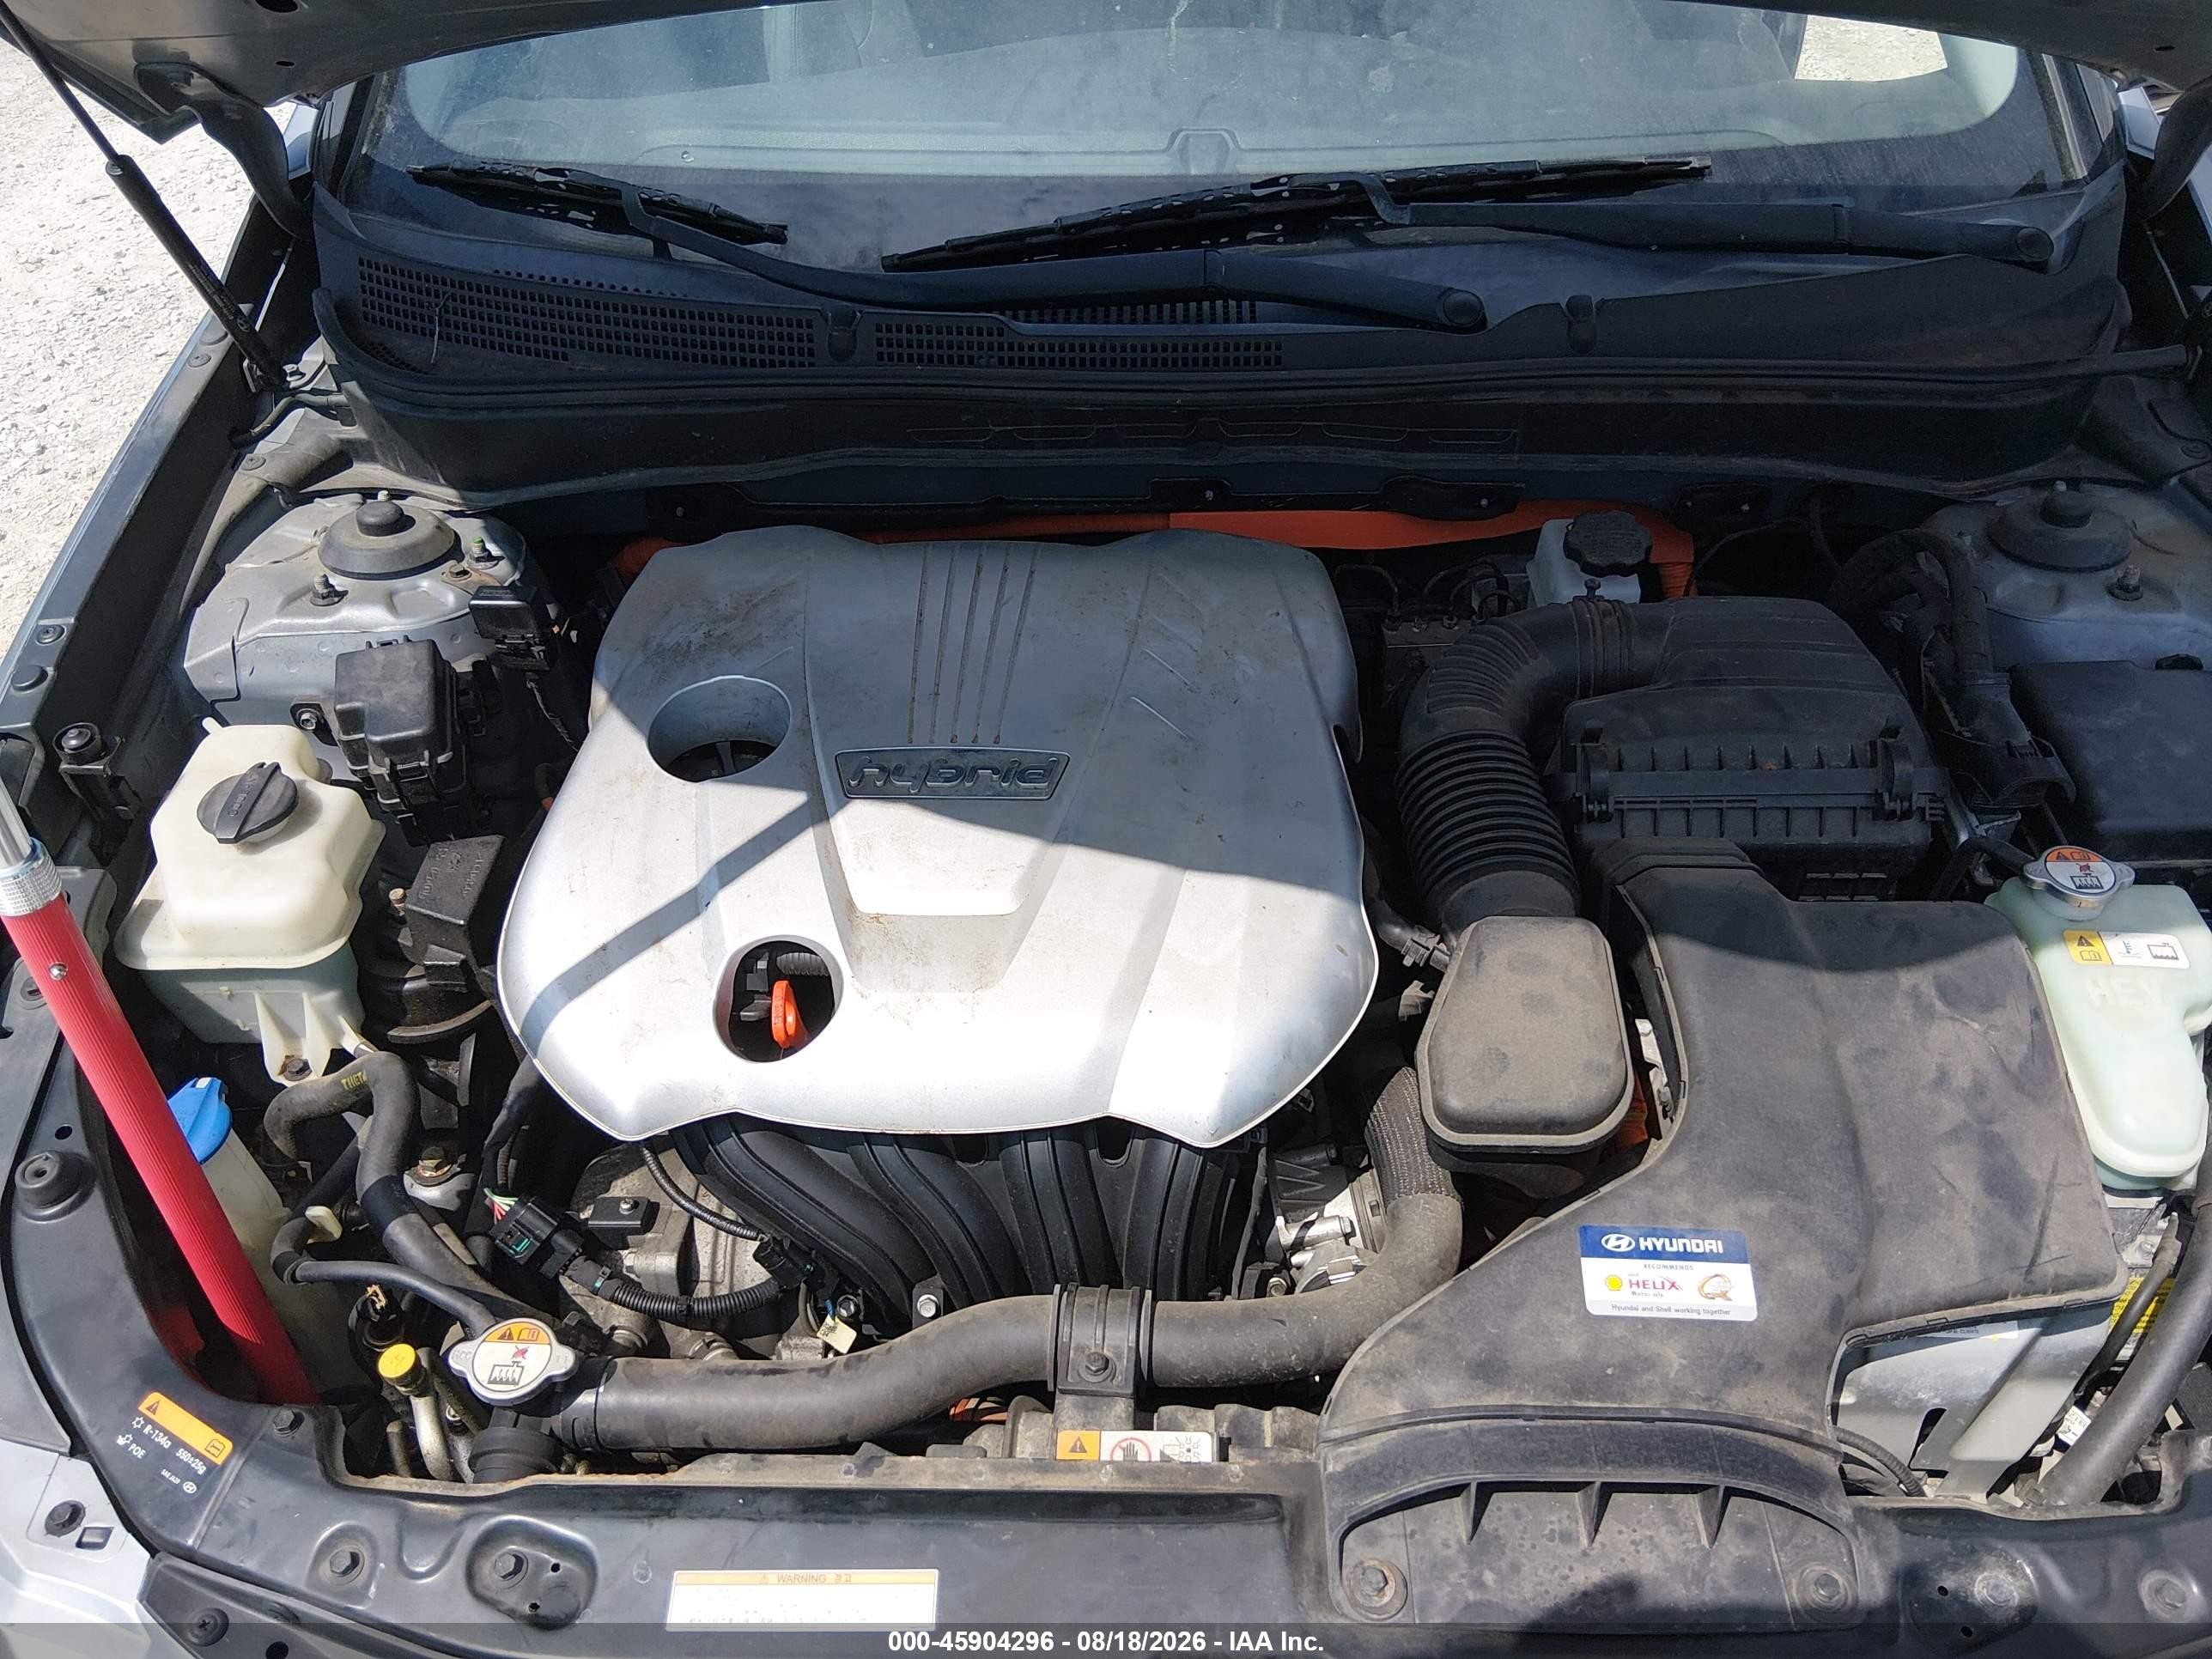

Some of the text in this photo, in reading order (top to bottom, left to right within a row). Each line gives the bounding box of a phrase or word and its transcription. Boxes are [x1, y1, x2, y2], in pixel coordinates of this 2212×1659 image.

[848, 757, 1059, 793] hybrid
[1638, 1237, 1724, 1254] HYUNDAI
[1629, 1277, 1682, 1291] HELIX
[1611, 1304, 1639, 1312] Hyundai
[1674, 1306, 1701, 1316] working
[1702, 1308, 1731, 1316] together
[128, 1443, 147, 1459] POE
[143, 1424, 207, 1475] R-134a 550±25g
[776, 1573, 827, 1583] WARNING
